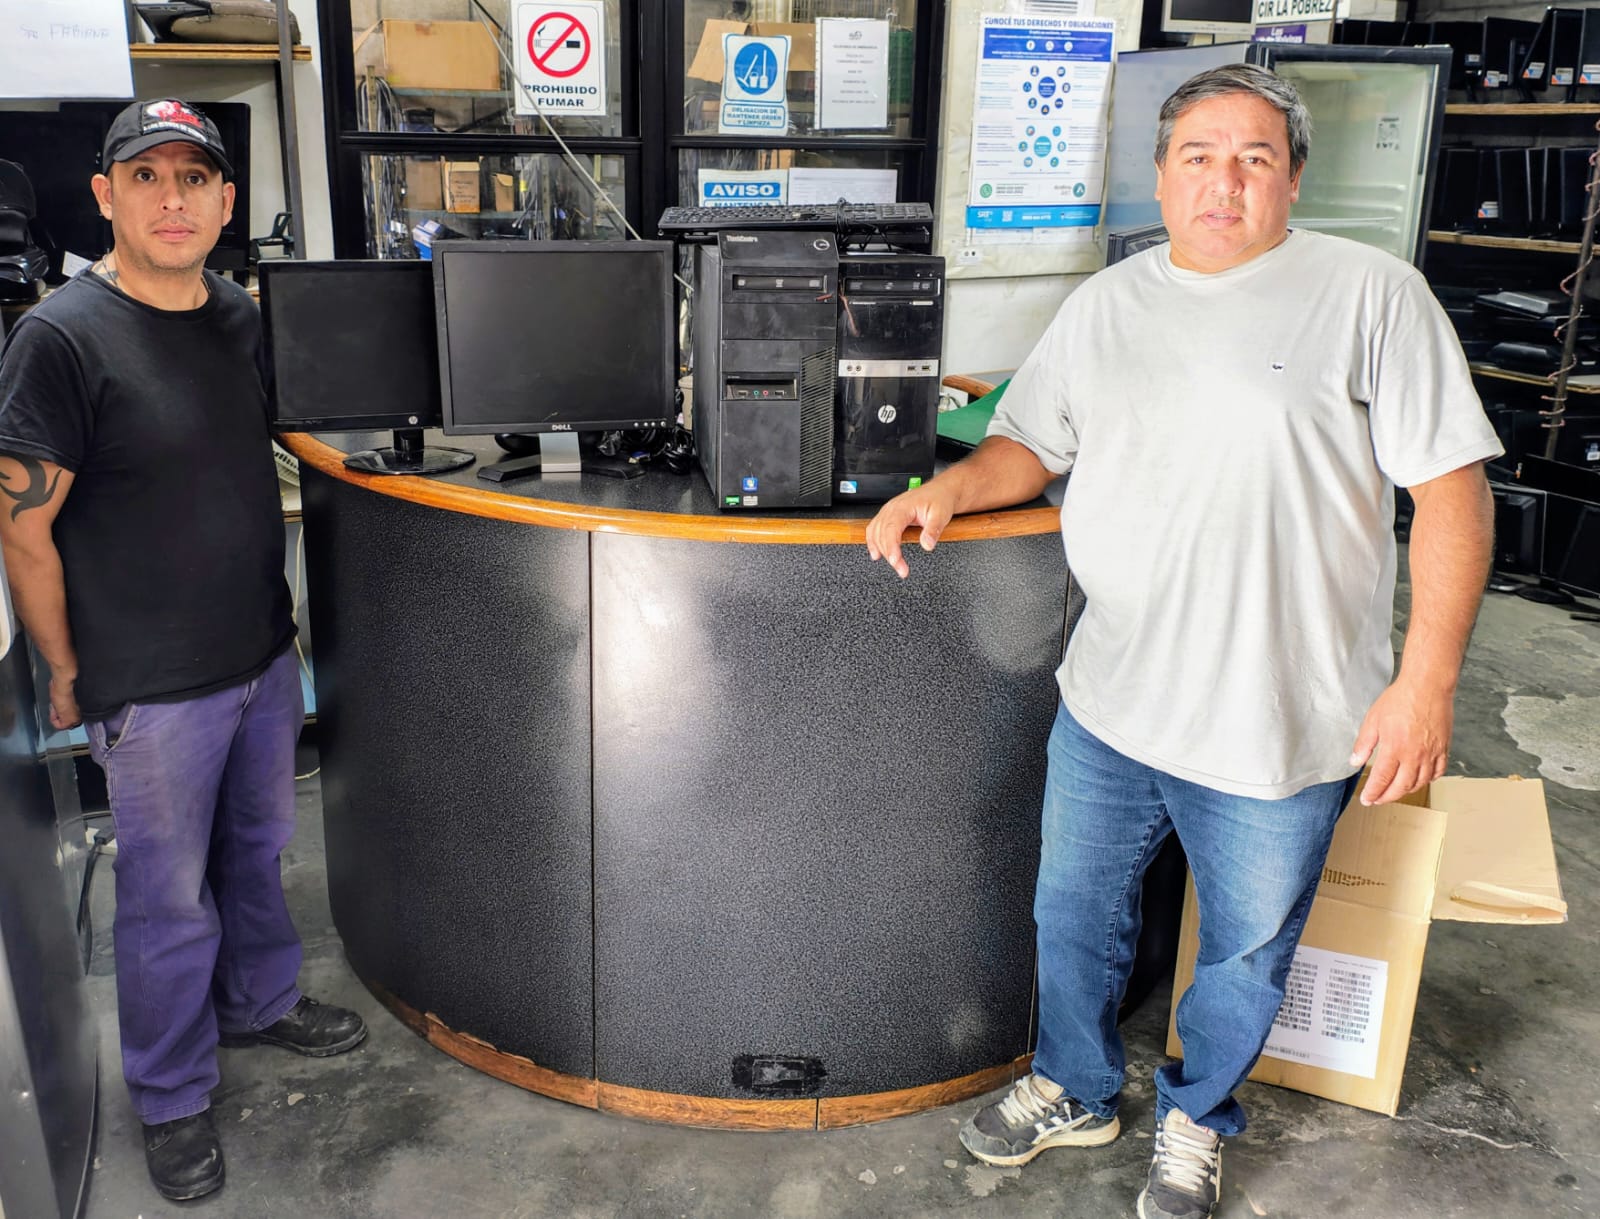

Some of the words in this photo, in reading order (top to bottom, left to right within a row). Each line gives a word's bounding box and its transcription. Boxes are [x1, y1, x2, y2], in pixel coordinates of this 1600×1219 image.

[1277, 0, 1288, 16] LA
[1013, 18, 1025, 27] TUS
[1026, 18, 1062, 28] DERECHOS
[1068, 20, 1114, 29] OBLIGACIONES
[523, 84, 598, 95] PROHIBIDO
[538, 97, 584, 107] FUMAR
[710, 184, 775, 197] AVISO
[880, 404, 895, 423] hp
